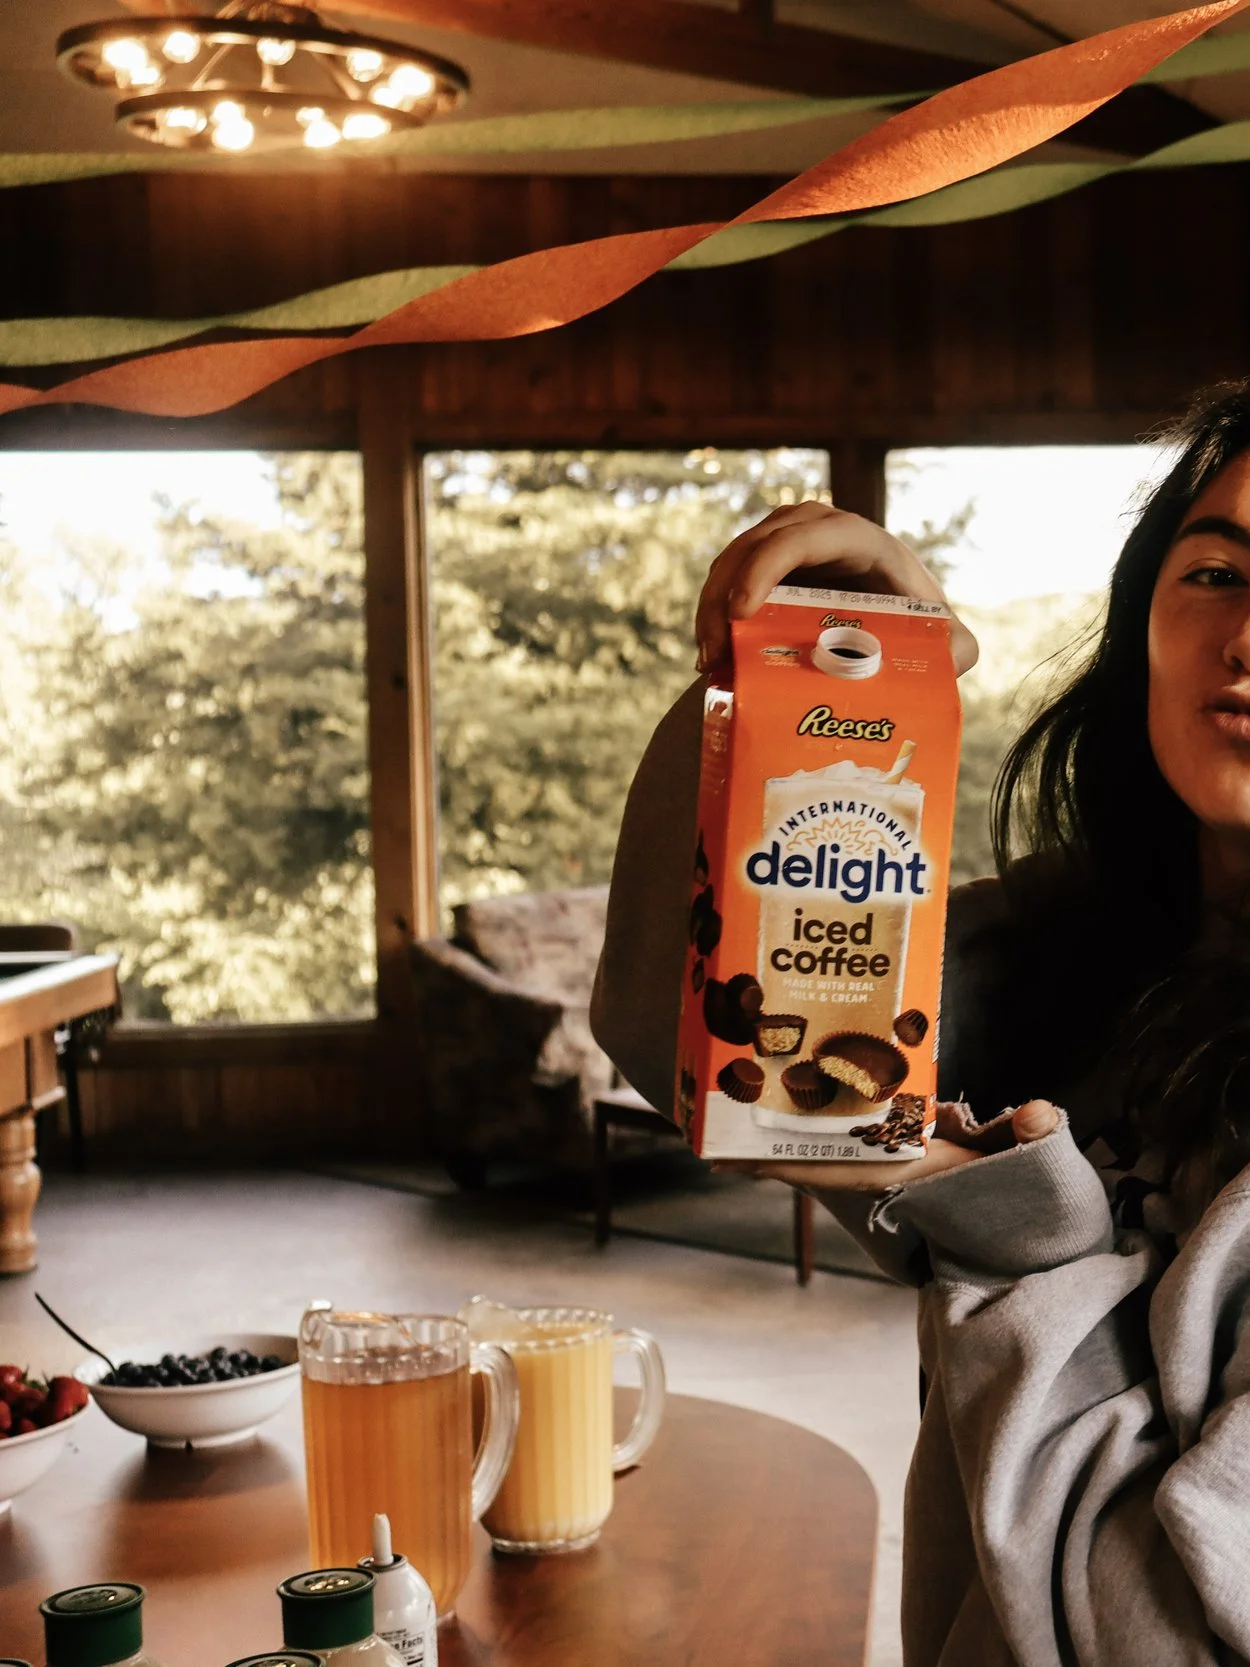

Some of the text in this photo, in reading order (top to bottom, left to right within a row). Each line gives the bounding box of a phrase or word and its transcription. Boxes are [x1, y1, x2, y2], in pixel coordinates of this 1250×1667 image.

[820, 613, 862, 628] Reese's
[797, 705, 896, 742] Reese's
[779, 800, 914, 851] INTERNATIONAL
[746, 841, 927, 903] delight
[793, 908, 873, 945] iced
[771, 946, 890, 977] coffee
[783, 977, 875, 992] MADE WITH REAL
[790, 990, 869, 1004] MILK & CREAM
[785, 1143, 794, 1155] FL
[797, 1144, 809, 1156] OZ
[855, 1145, 861, 1157] L
